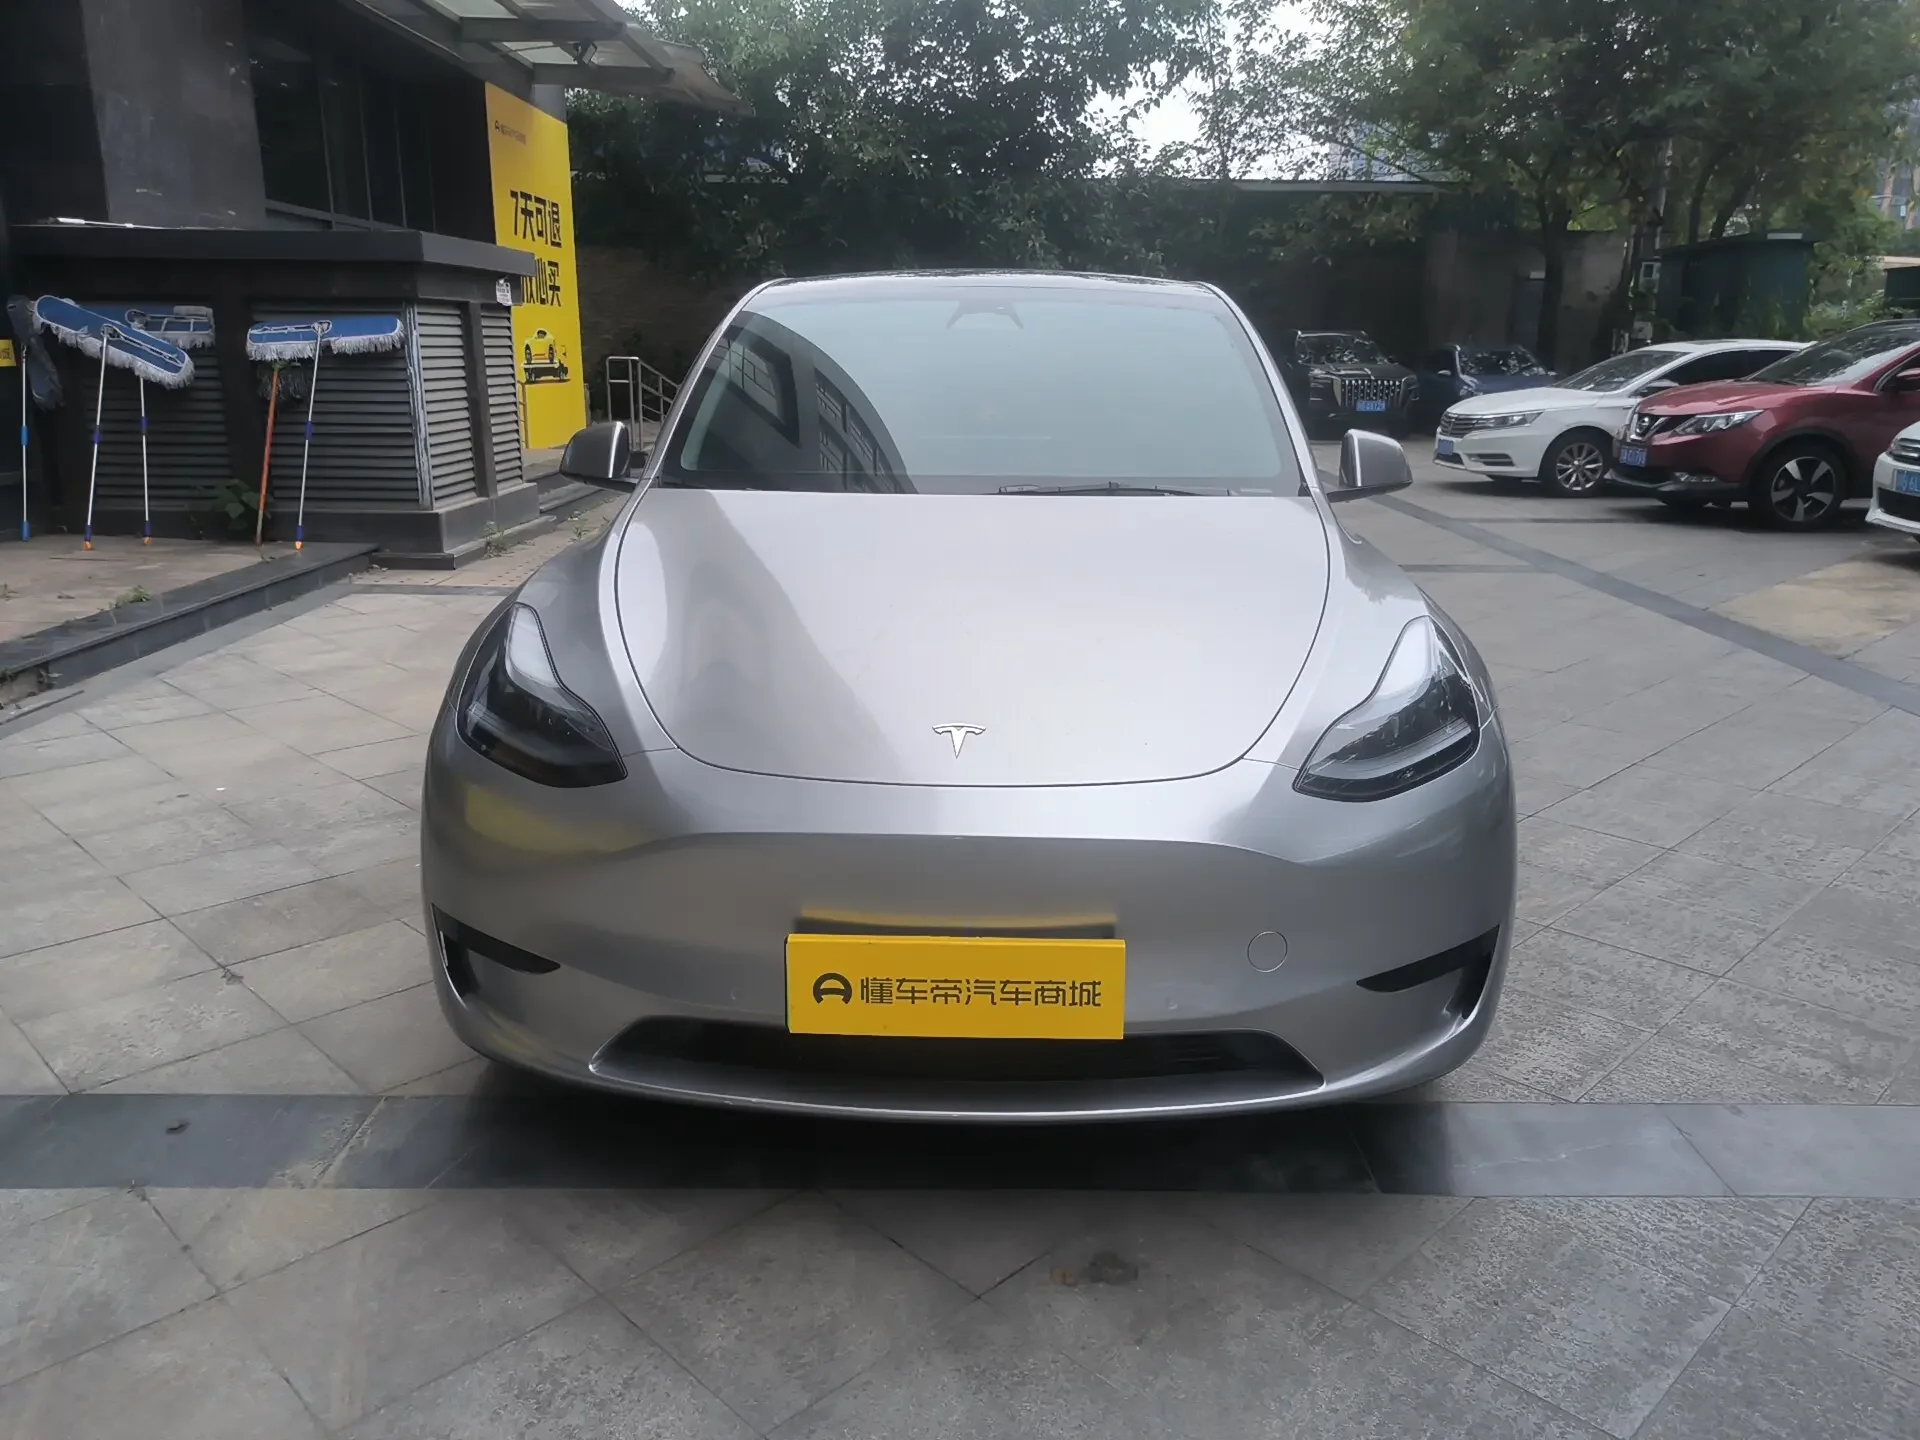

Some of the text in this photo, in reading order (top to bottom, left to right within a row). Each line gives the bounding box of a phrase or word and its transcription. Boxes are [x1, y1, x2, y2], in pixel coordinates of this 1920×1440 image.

[509, 189, 562, 248] 7天可退
[860, 976, 1102, 1007] 懂车帝汽车商城
